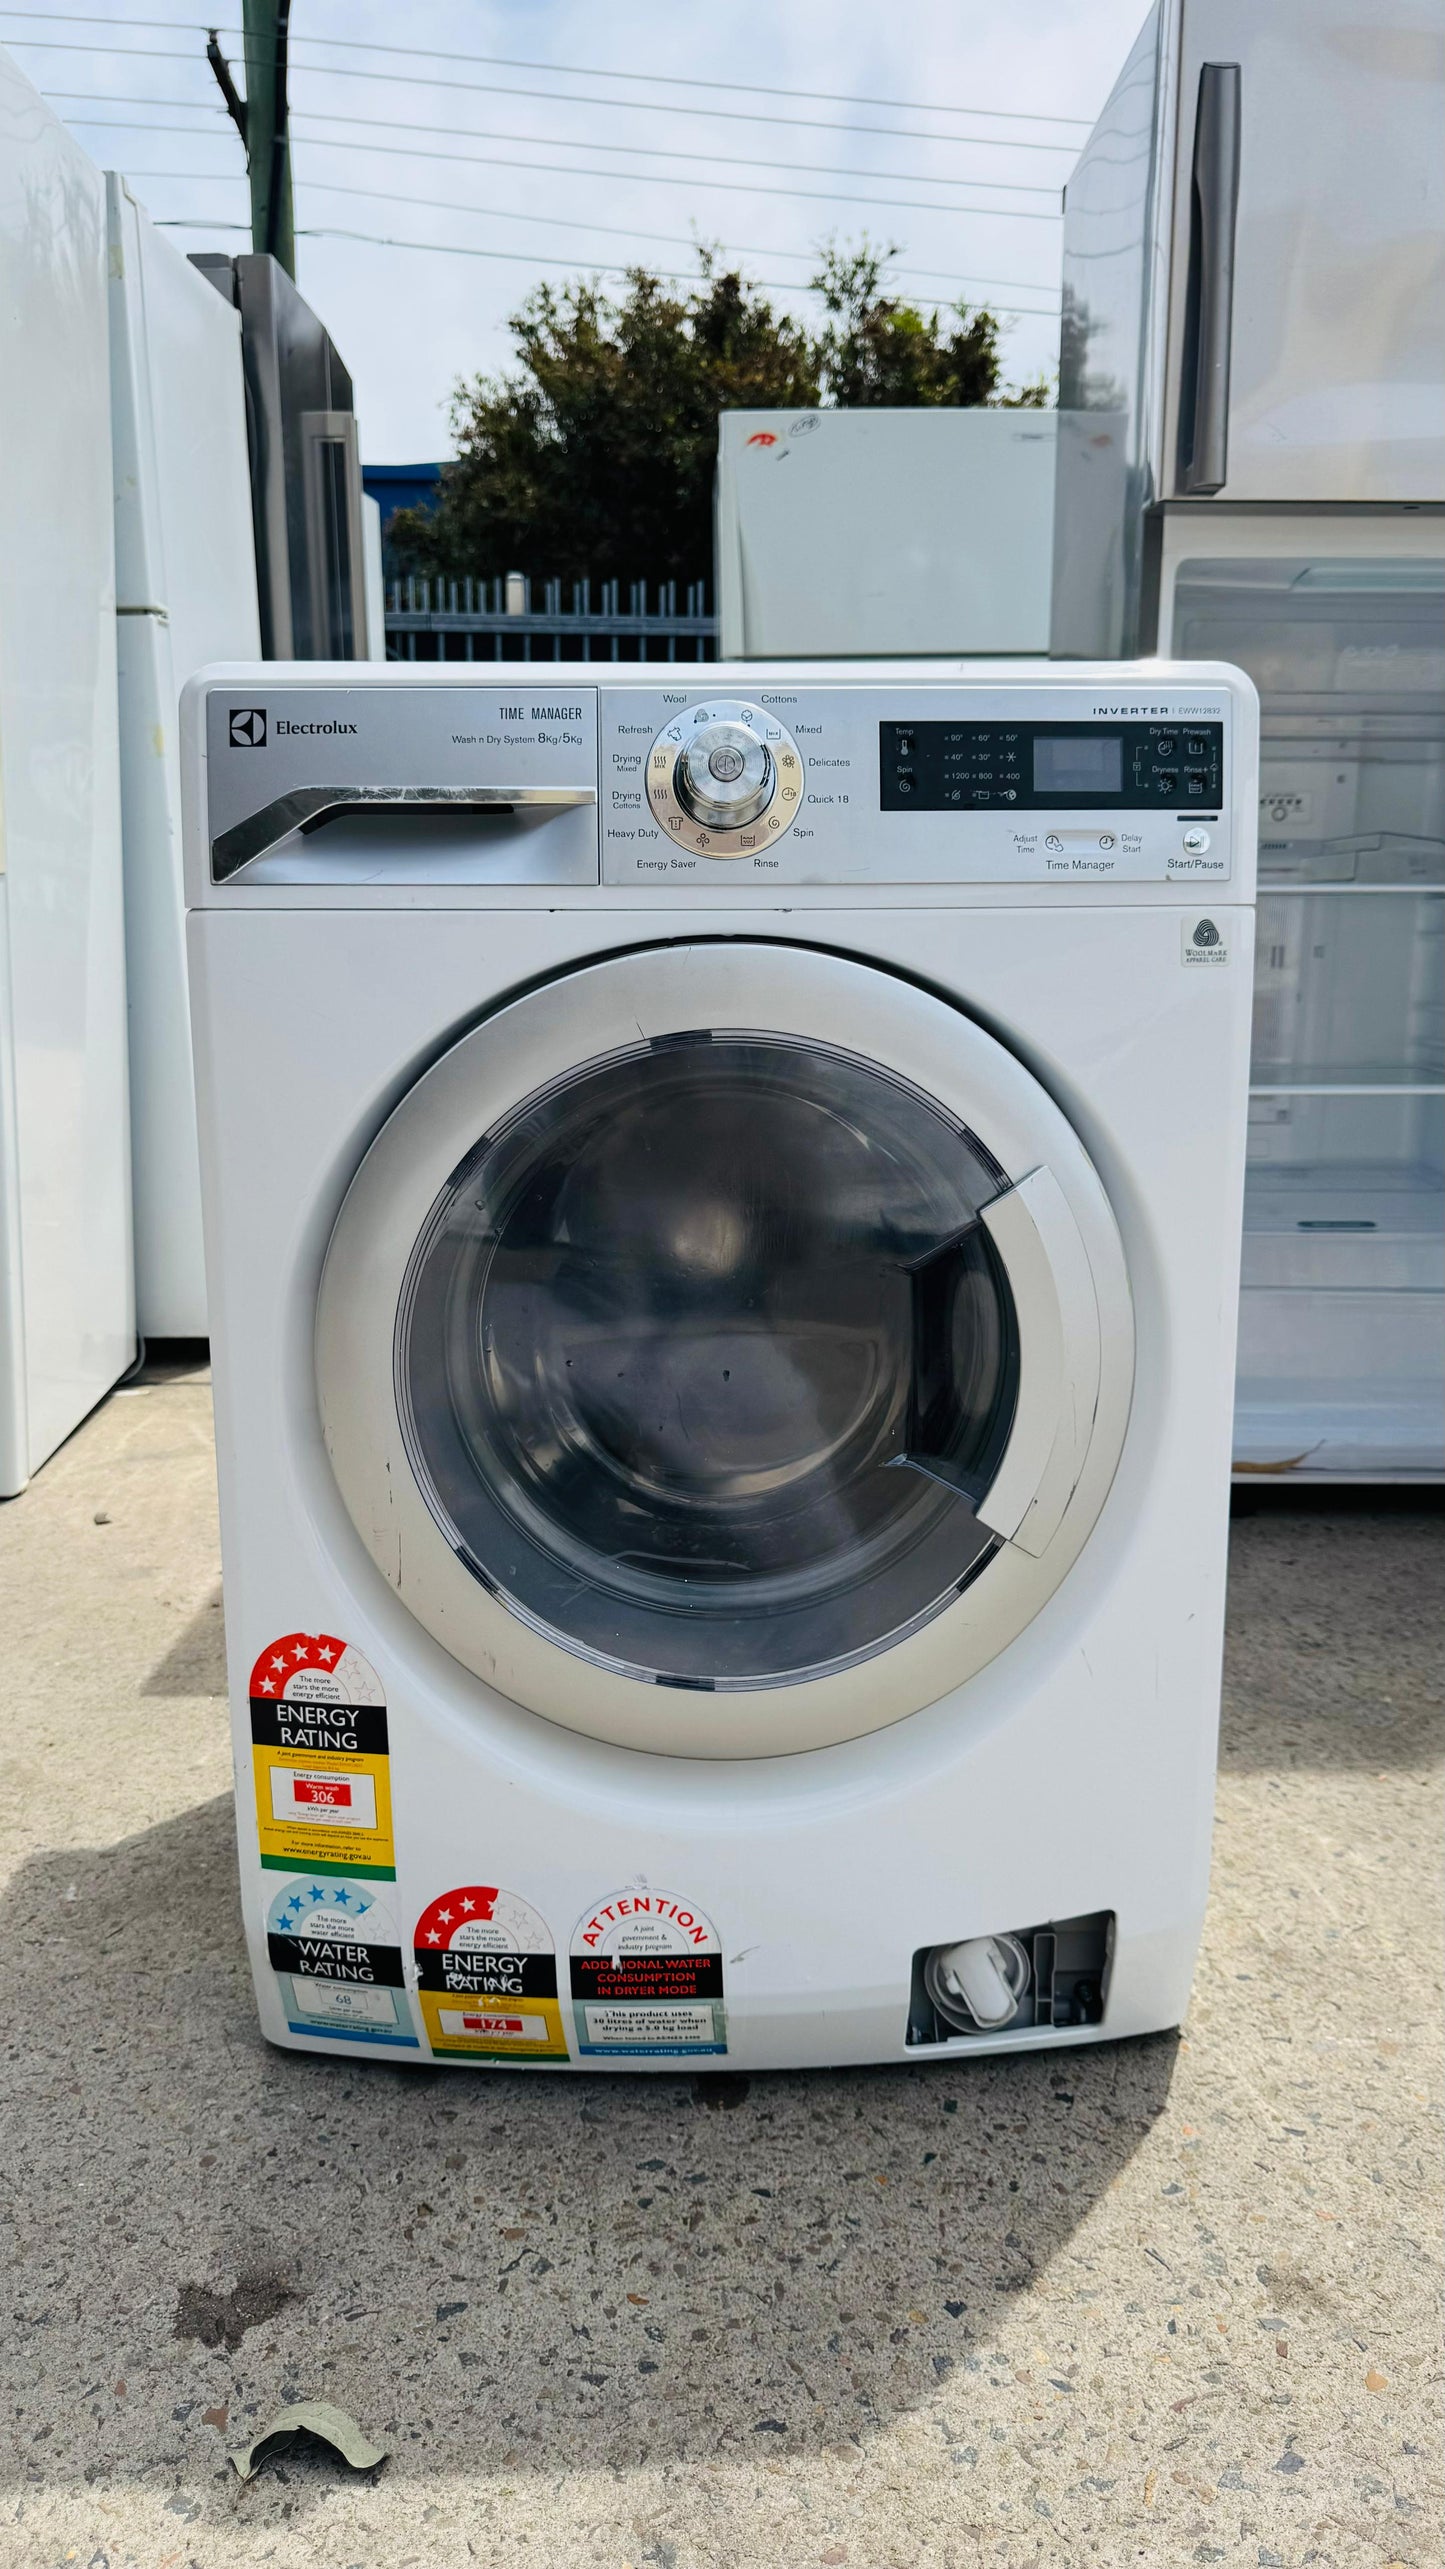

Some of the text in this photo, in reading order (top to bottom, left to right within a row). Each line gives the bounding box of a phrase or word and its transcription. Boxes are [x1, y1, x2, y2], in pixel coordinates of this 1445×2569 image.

[663, 695, 686, 703] Wool
[762, 695, 797, 703] Cottons
[499, 708, 582, 720] TIME MANAGER
[276, 721, 358, 734] Electrolux
[618, 725, 652, 734] Refresh
[796, 725, 822, 734] Mixed
[896, 728, 914, 736] Temp
[1150, 728, 1161, 736] Dry
[487, 736, 501, 745] Dry
[504, 736, 535, 745] System
[538, 733, 582, 745] 8Kg/5Kg
[612, 755, 641, 766] Drying
[808, 758, 850, 766] Delicates
[897, 766, 912, 774] Spin
[612, 792, 640, 803] Drying
[808, 795, 848, 804] Quick 18
[608, 829, 658, 839] Heavy Duty
[793, 828, 814, 837] Spin
[1013, 835, 1038, 844] Adjust
[1121, 834, 1142, 843] Delay
[637, 860, 696, 870] Energy Saver
[754, 860, 779, 868] Rinse
[1046, 861, 1114, 871] Time Manager
[1167, 859, 1224, 869] Start/Pause
[277, 1704, 360, 1727] ENERGY
[281, 1727, 358, 1750] RATING
[314, 1773, 349, 1782] consumption
[311, 1790, 334, 1804] 306
[582, 1897, 708, 1947] ATTENTION
[298, 1940, 370, 1963] WATER
[442, 1954, 528, 1974] ENERGY
[665, 1959, 710, 1969] WATER
[300, 1960, 374, 1981] RATING
[597, 1972, 696, 1983] CONSUMPTION
[446, 1974, 523, 1994] RATING
[598, 1985, 696, 1995] IN DRYER MODE
[336, 1994, 352, 2004] 68
[629, 2010, 668, 2018] product
[481, 2020, 507, 2029] 174
